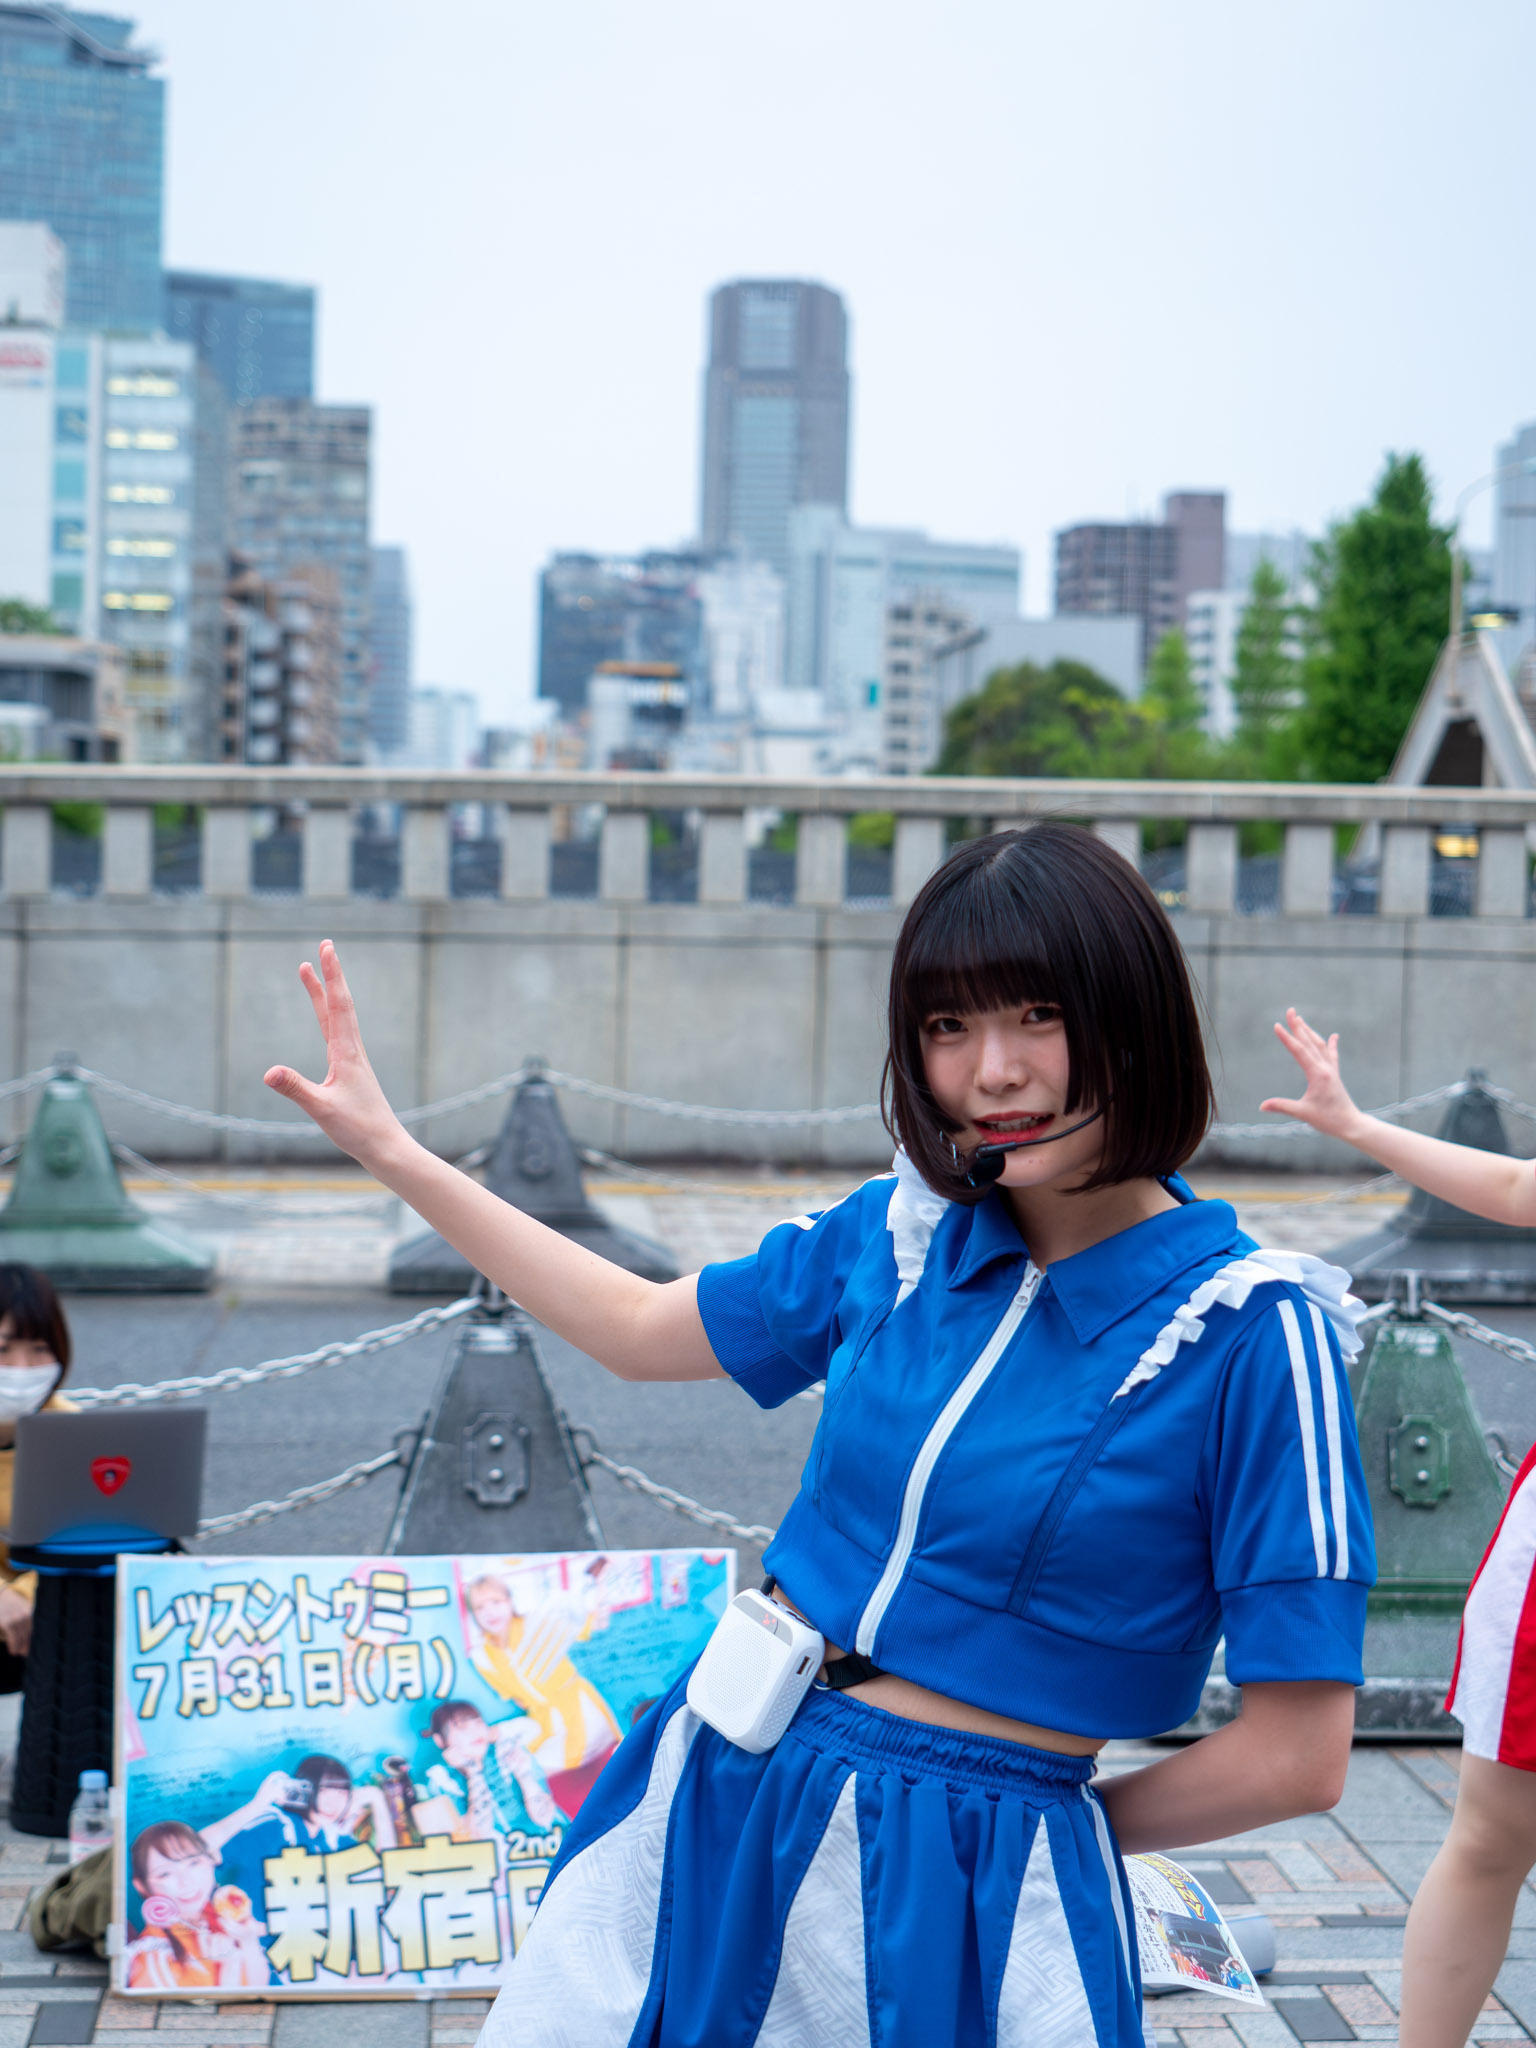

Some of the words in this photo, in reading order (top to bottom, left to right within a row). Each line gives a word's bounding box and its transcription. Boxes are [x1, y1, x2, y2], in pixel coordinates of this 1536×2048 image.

[133, 1570, 450, 1654] レッスントゥミー
[132, 1636, 456, 1719] 7月31日(月)
[505, 1825, 563, 1862] 2nd
